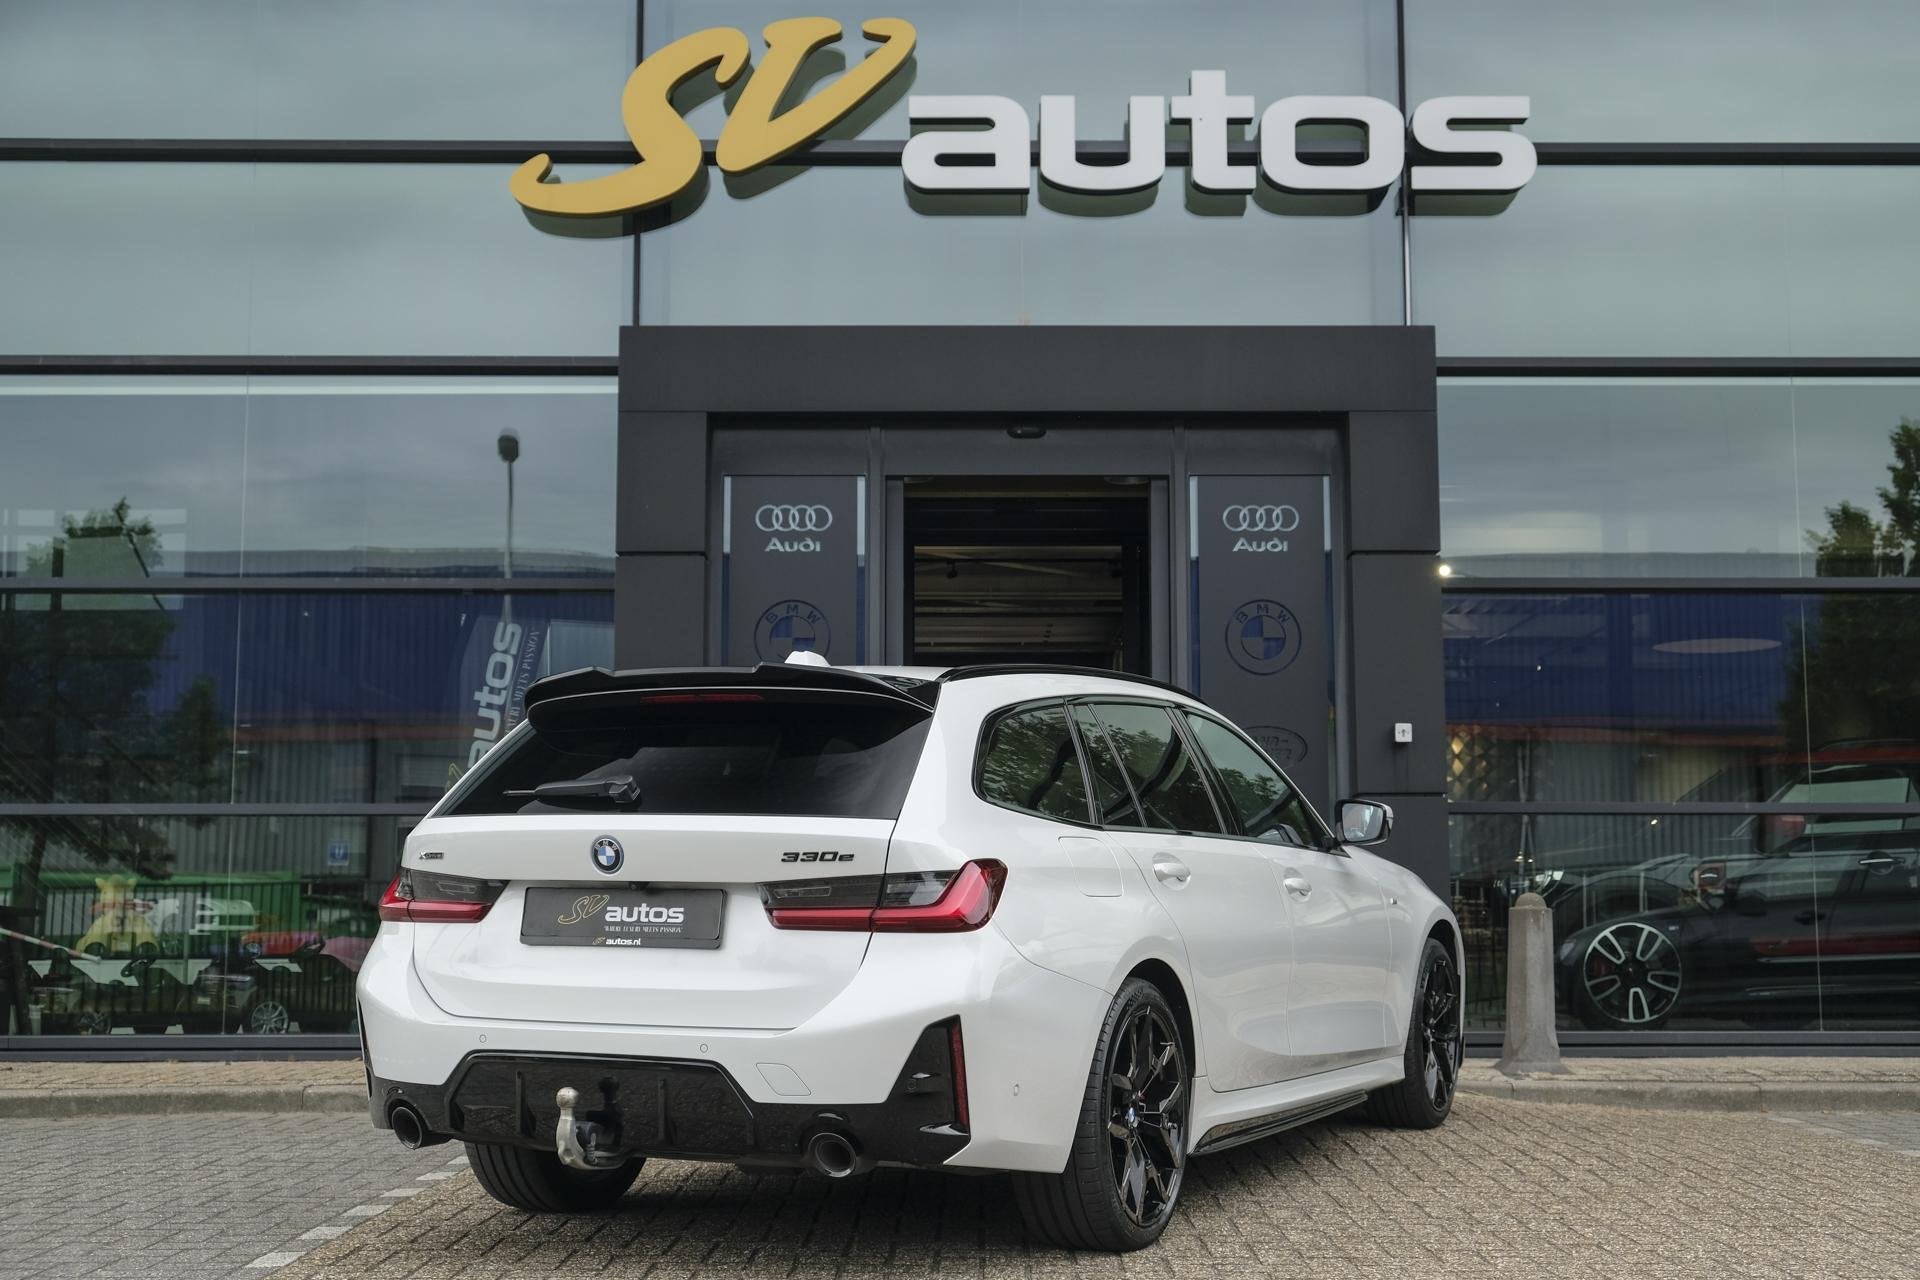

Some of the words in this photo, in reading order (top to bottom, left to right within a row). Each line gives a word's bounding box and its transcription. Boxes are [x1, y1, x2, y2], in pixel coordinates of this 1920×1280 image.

[509, 16, 917, 217] SV
[901, 70, 1538, 195] autos
[765, 537, 821, 552] Audi
[1232, 537, 1288, 552] Audi
[766, 604, 821, 625] BMW
[1236, 604, 1290, 624] BMW
[468, 621, 522, 769] autos
[781, 851, 855, 862] 330e
[558, 894, 610, 925] SV
[605, 903, 685, 923] autos
